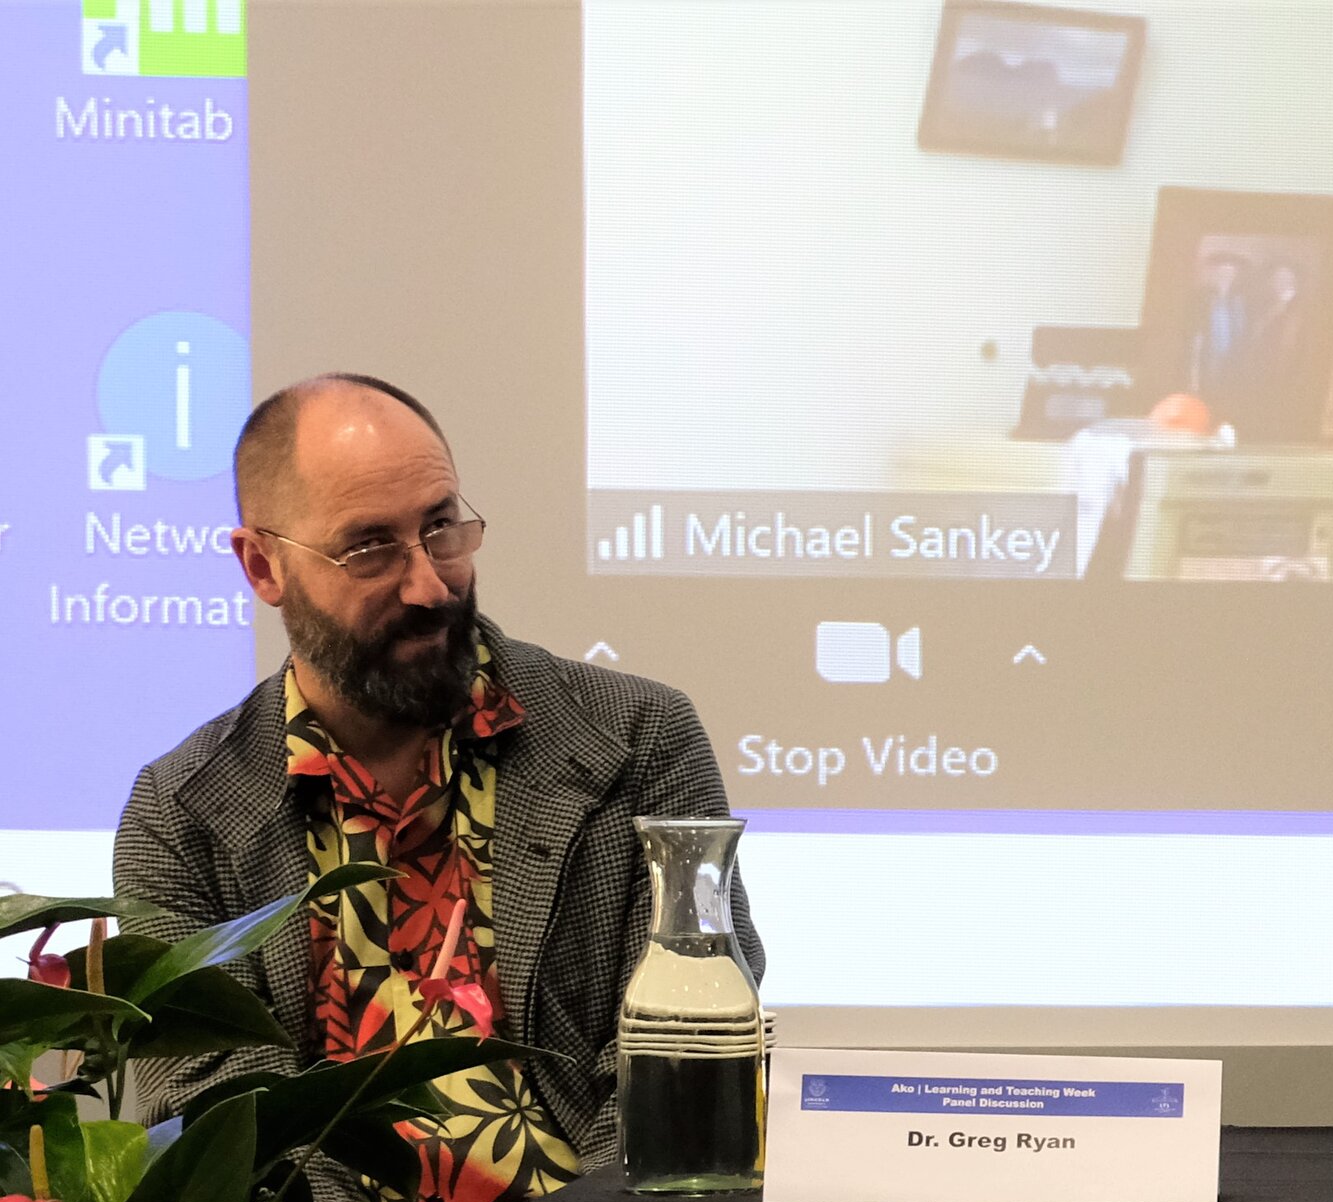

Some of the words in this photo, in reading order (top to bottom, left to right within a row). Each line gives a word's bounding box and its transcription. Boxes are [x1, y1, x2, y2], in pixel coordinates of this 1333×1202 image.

[55, 96, 234, 141] Minitab
[686, 511, 874, 560] Michael
[890, 514, 1061, 573] Sankey
[49, 581, 250, 626] Informat
[737, 734, 847, 786] Stop
[862, 734, 999, 776] Video
[891, 1084, 914, 1094] Ako
[924, 1085, 977, 1096] Learning
[980, 1088, 1003, 1096] and
[1006, 1086, 1060, 1099] Teaching
[1063, 1088, 1096, 1098] Week
[942, 1098, 976, 1108] Panel
[979, 1099, 1044, 1109] Discussion
[907, 1131, 939, 1148] Dr.
[948, 1132, 1007, 1152] Greg
[1016, 1133, 1076, 1153] Ryan
